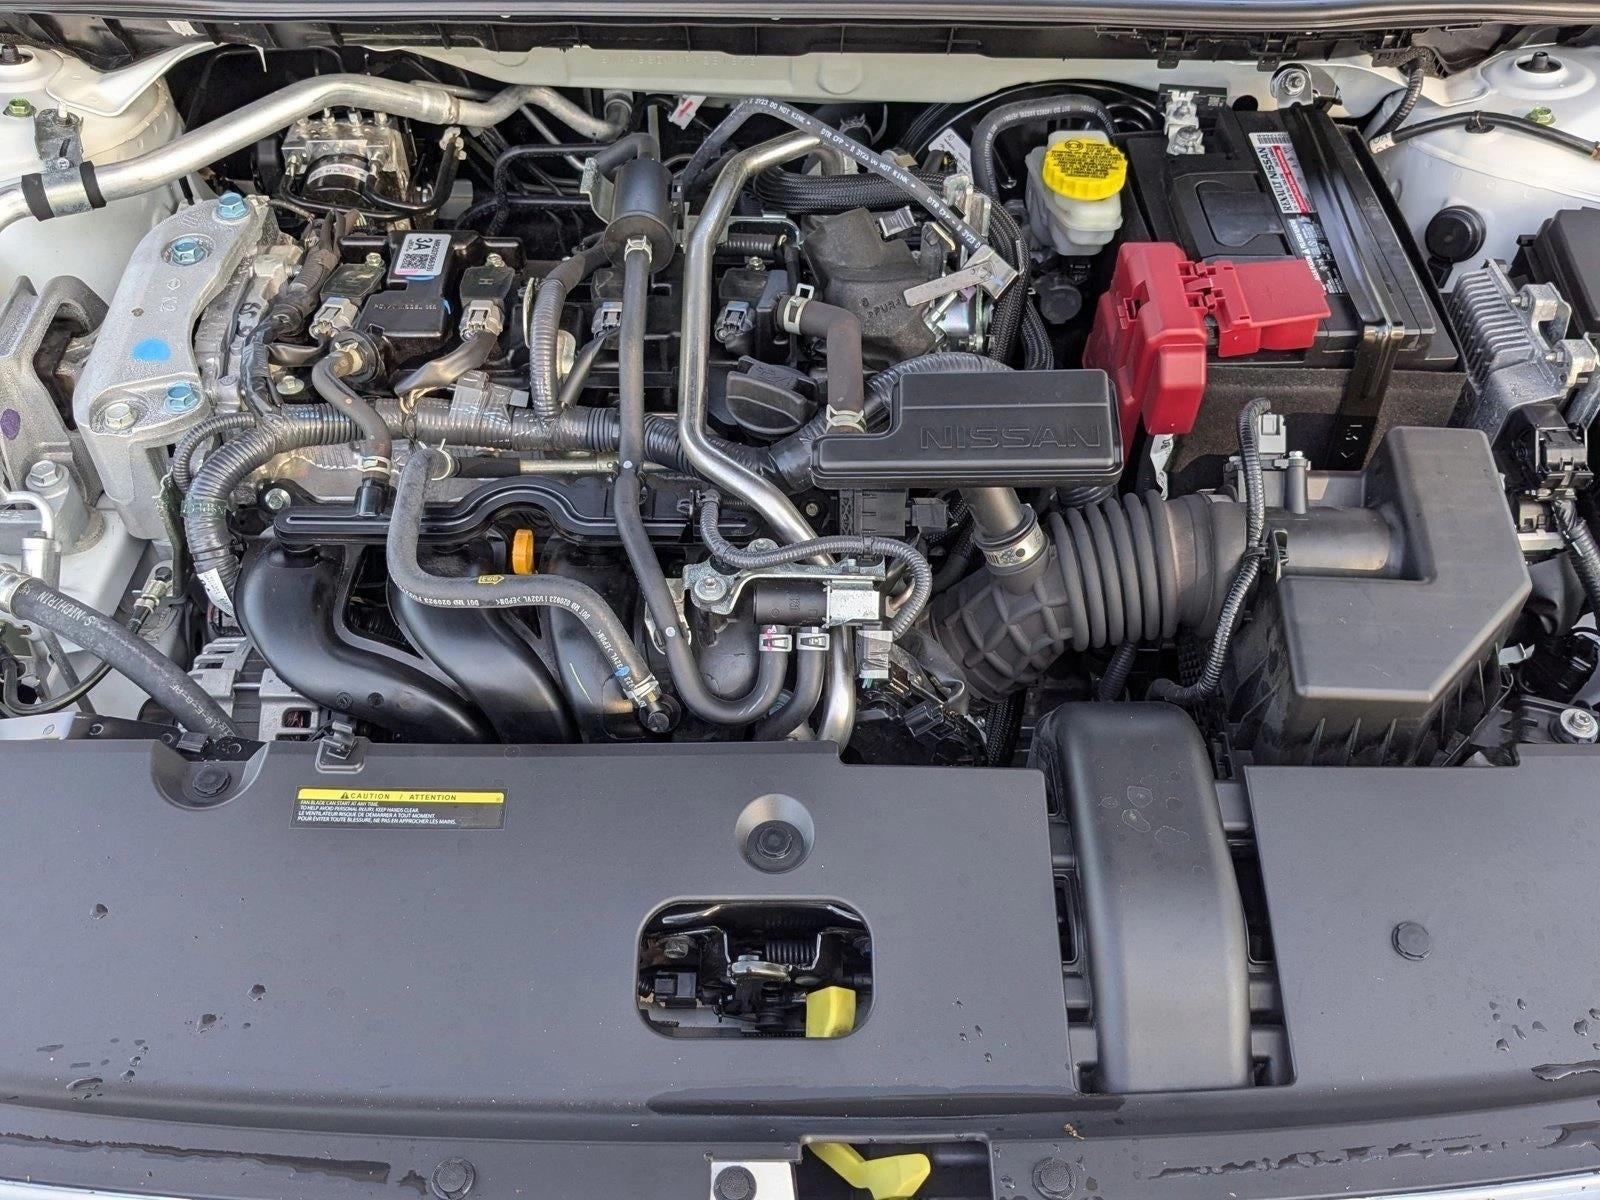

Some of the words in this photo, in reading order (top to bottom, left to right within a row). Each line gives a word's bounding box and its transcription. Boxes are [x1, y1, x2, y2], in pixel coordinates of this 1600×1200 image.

[1258, 146, 1278, 179] NISSAN
[413, 237, 433, 250] 3A
[921, 426, 1101, 449] NISSAN
